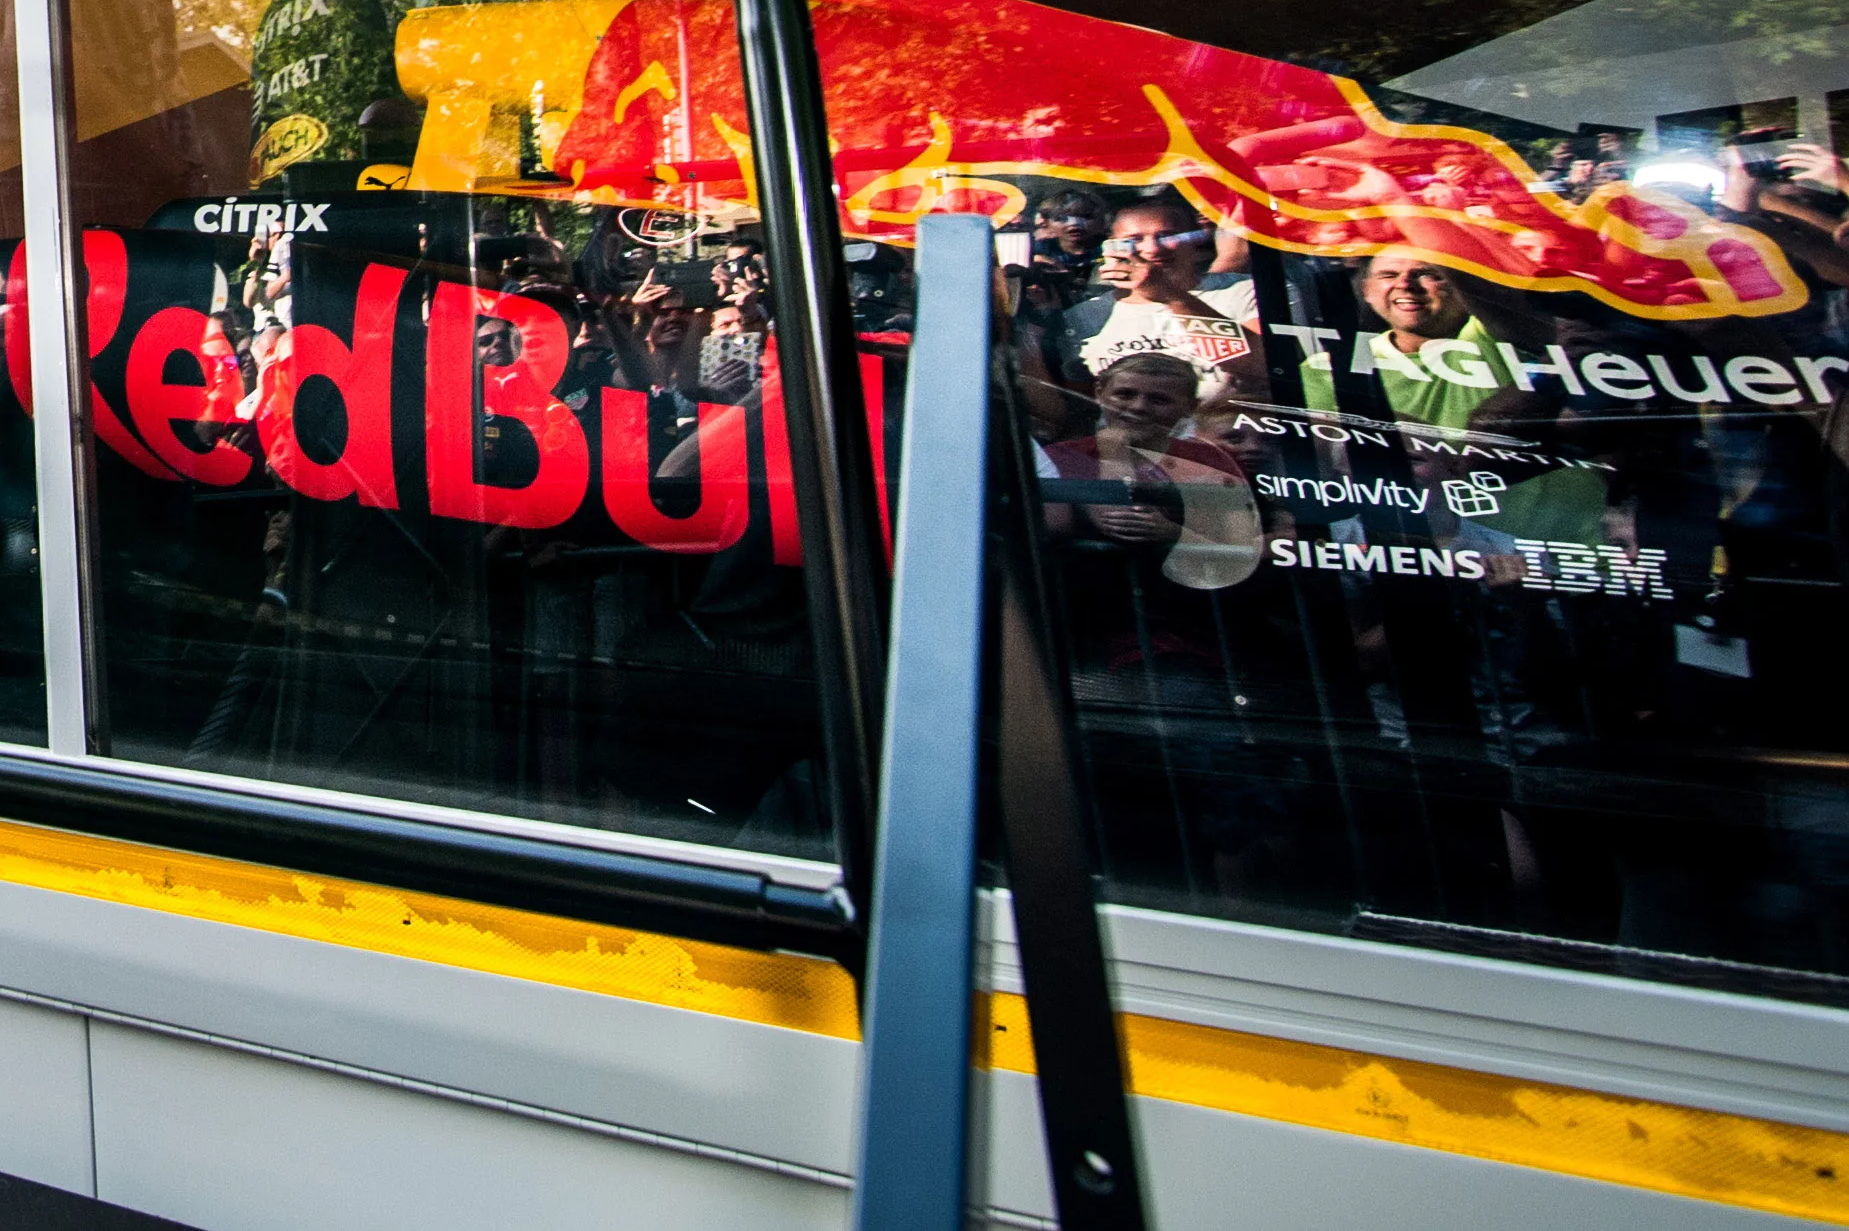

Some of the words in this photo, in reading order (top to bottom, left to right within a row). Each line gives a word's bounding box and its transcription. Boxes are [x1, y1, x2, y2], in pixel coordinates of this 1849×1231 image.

[267, 53, 329, 103] AT&T
[260, 128, 310, 162] AUCH
[1232, 412, 1391, 448] ASTON
[1270, 537, 1486, 580] SIEMENS
[1514, 538, 1675, 600] IBM
